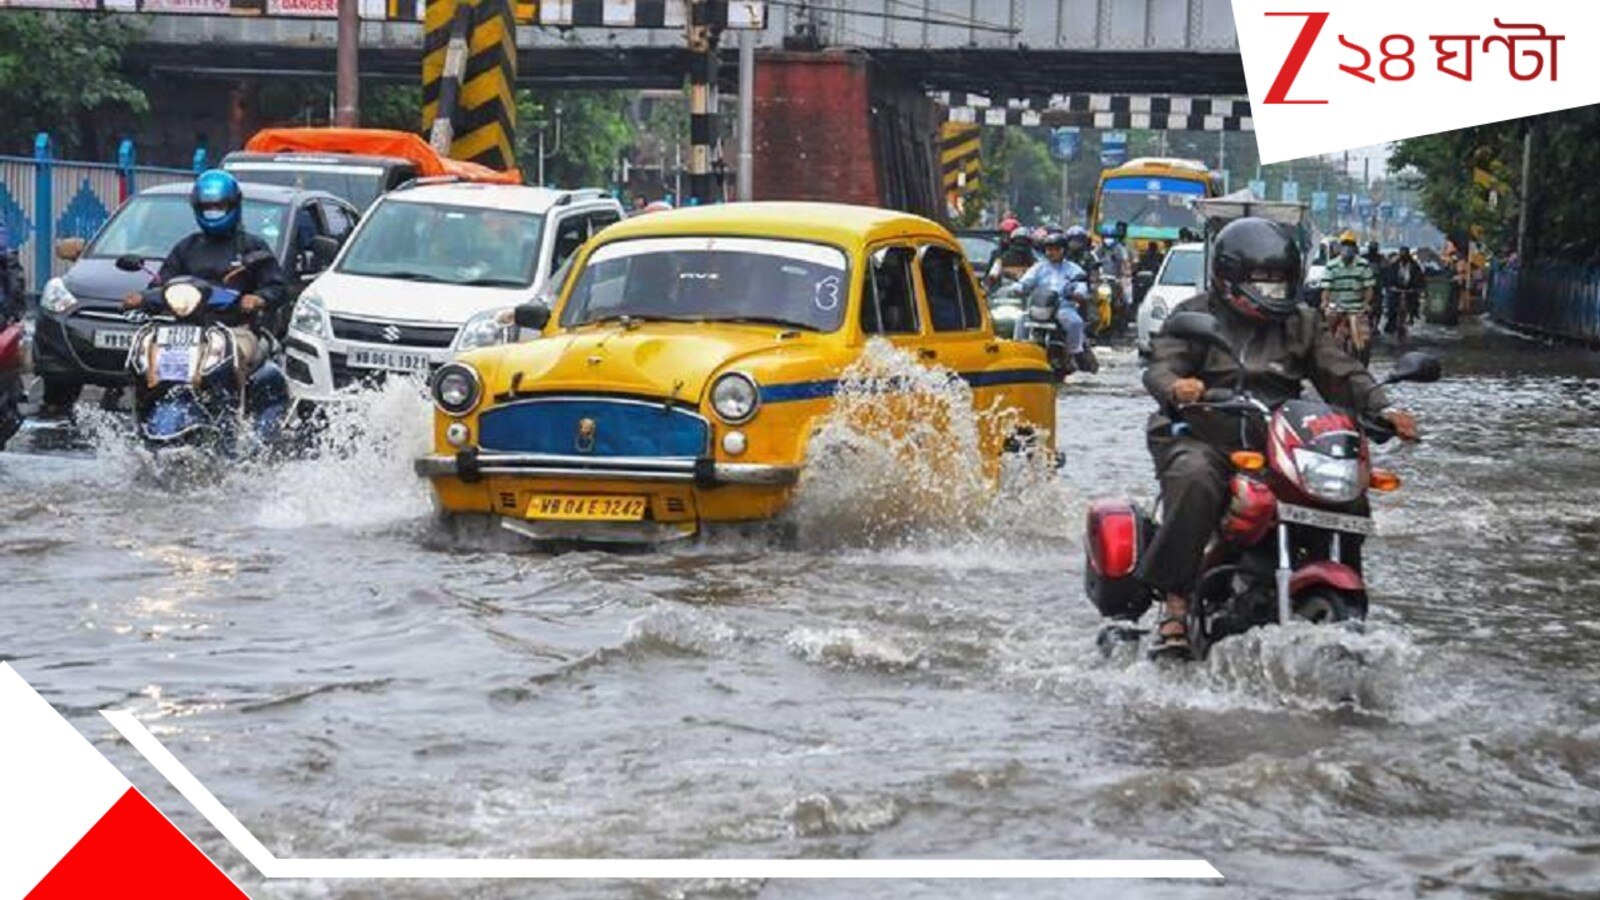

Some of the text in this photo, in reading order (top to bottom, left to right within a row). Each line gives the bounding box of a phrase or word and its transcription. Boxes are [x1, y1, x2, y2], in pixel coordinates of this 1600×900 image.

[541, 498, 560, 513] WB
[587, 499, 599, 514] E
[601, 500, 643, 516] 3242
